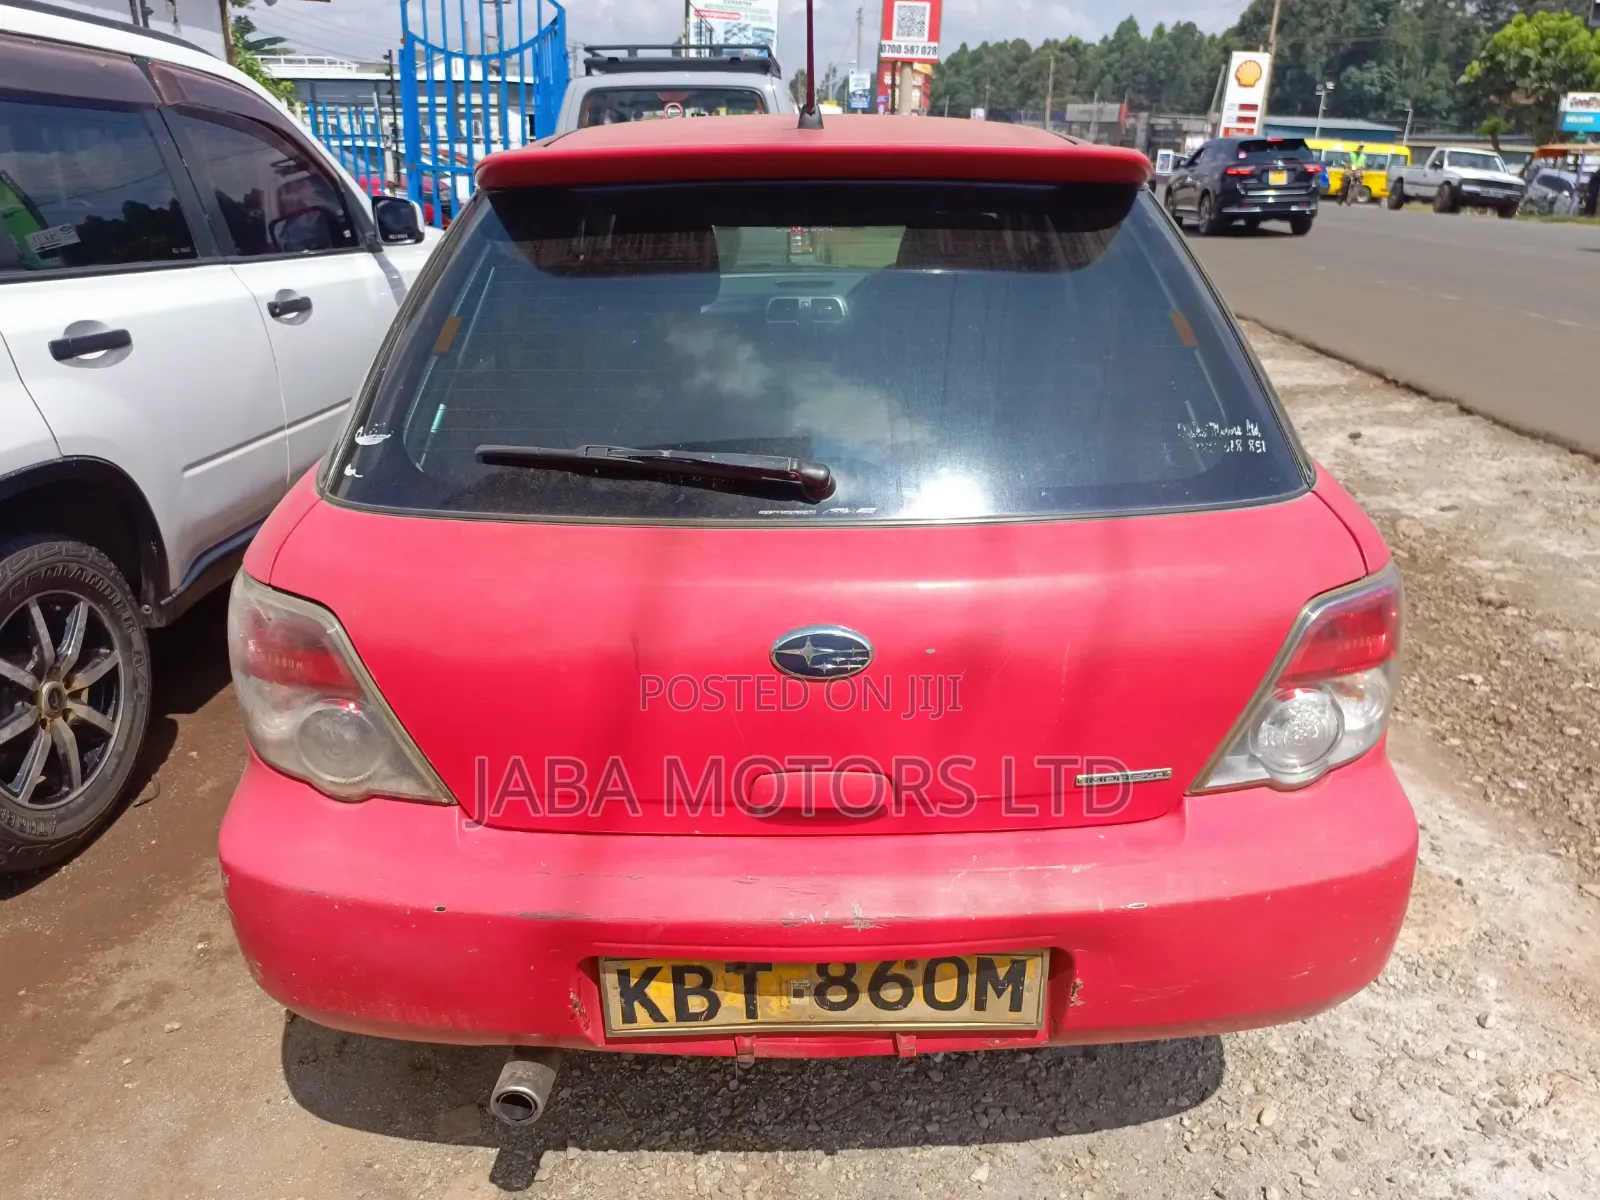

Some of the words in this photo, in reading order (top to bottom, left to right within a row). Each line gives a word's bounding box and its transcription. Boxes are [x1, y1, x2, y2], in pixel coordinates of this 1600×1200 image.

[903, 45, 919, 55] 587
[920, 46, 938, 56] 028
[1085, 770, 1167, 784] IMPREZA
[615, 961, 773, 1025] KBT
[813, 955, 1027, 1012] 860M
